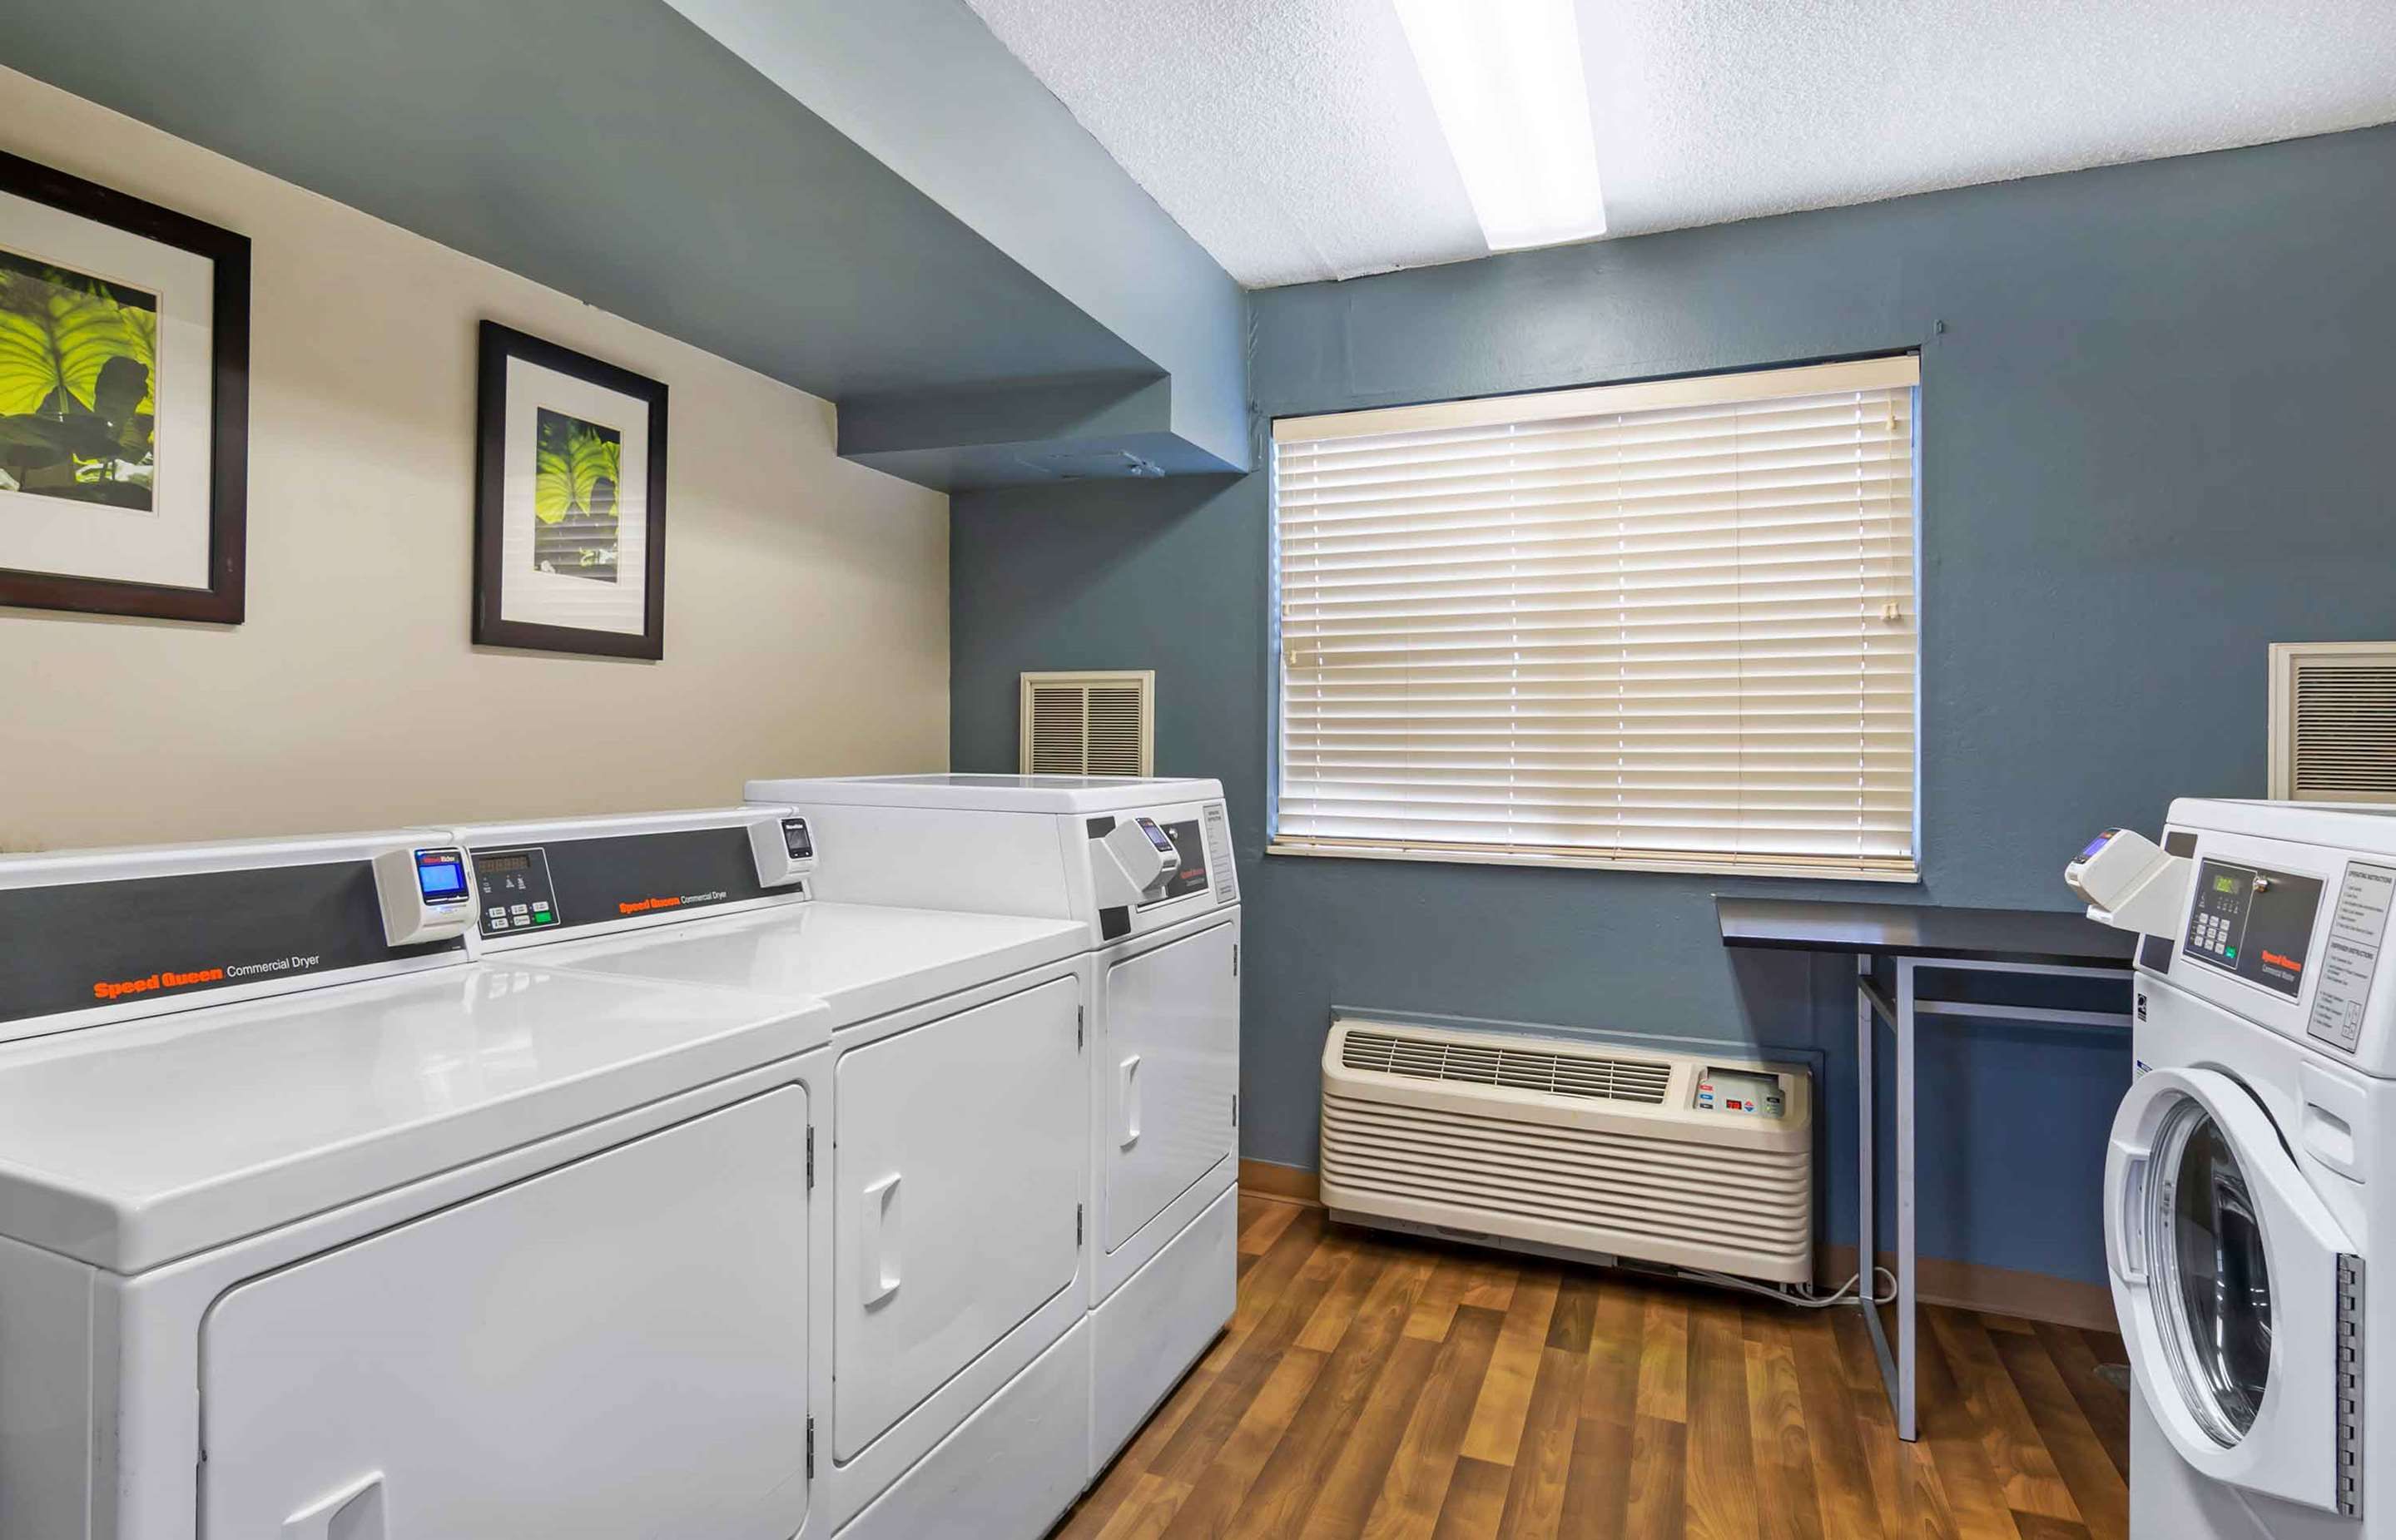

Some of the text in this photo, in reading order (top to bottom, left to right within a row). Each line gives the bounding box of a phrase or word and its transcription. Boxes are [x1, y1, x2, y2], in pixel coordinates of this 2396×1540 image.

[94, 954, 320, 998] Speed Queen Commercial Dryer
